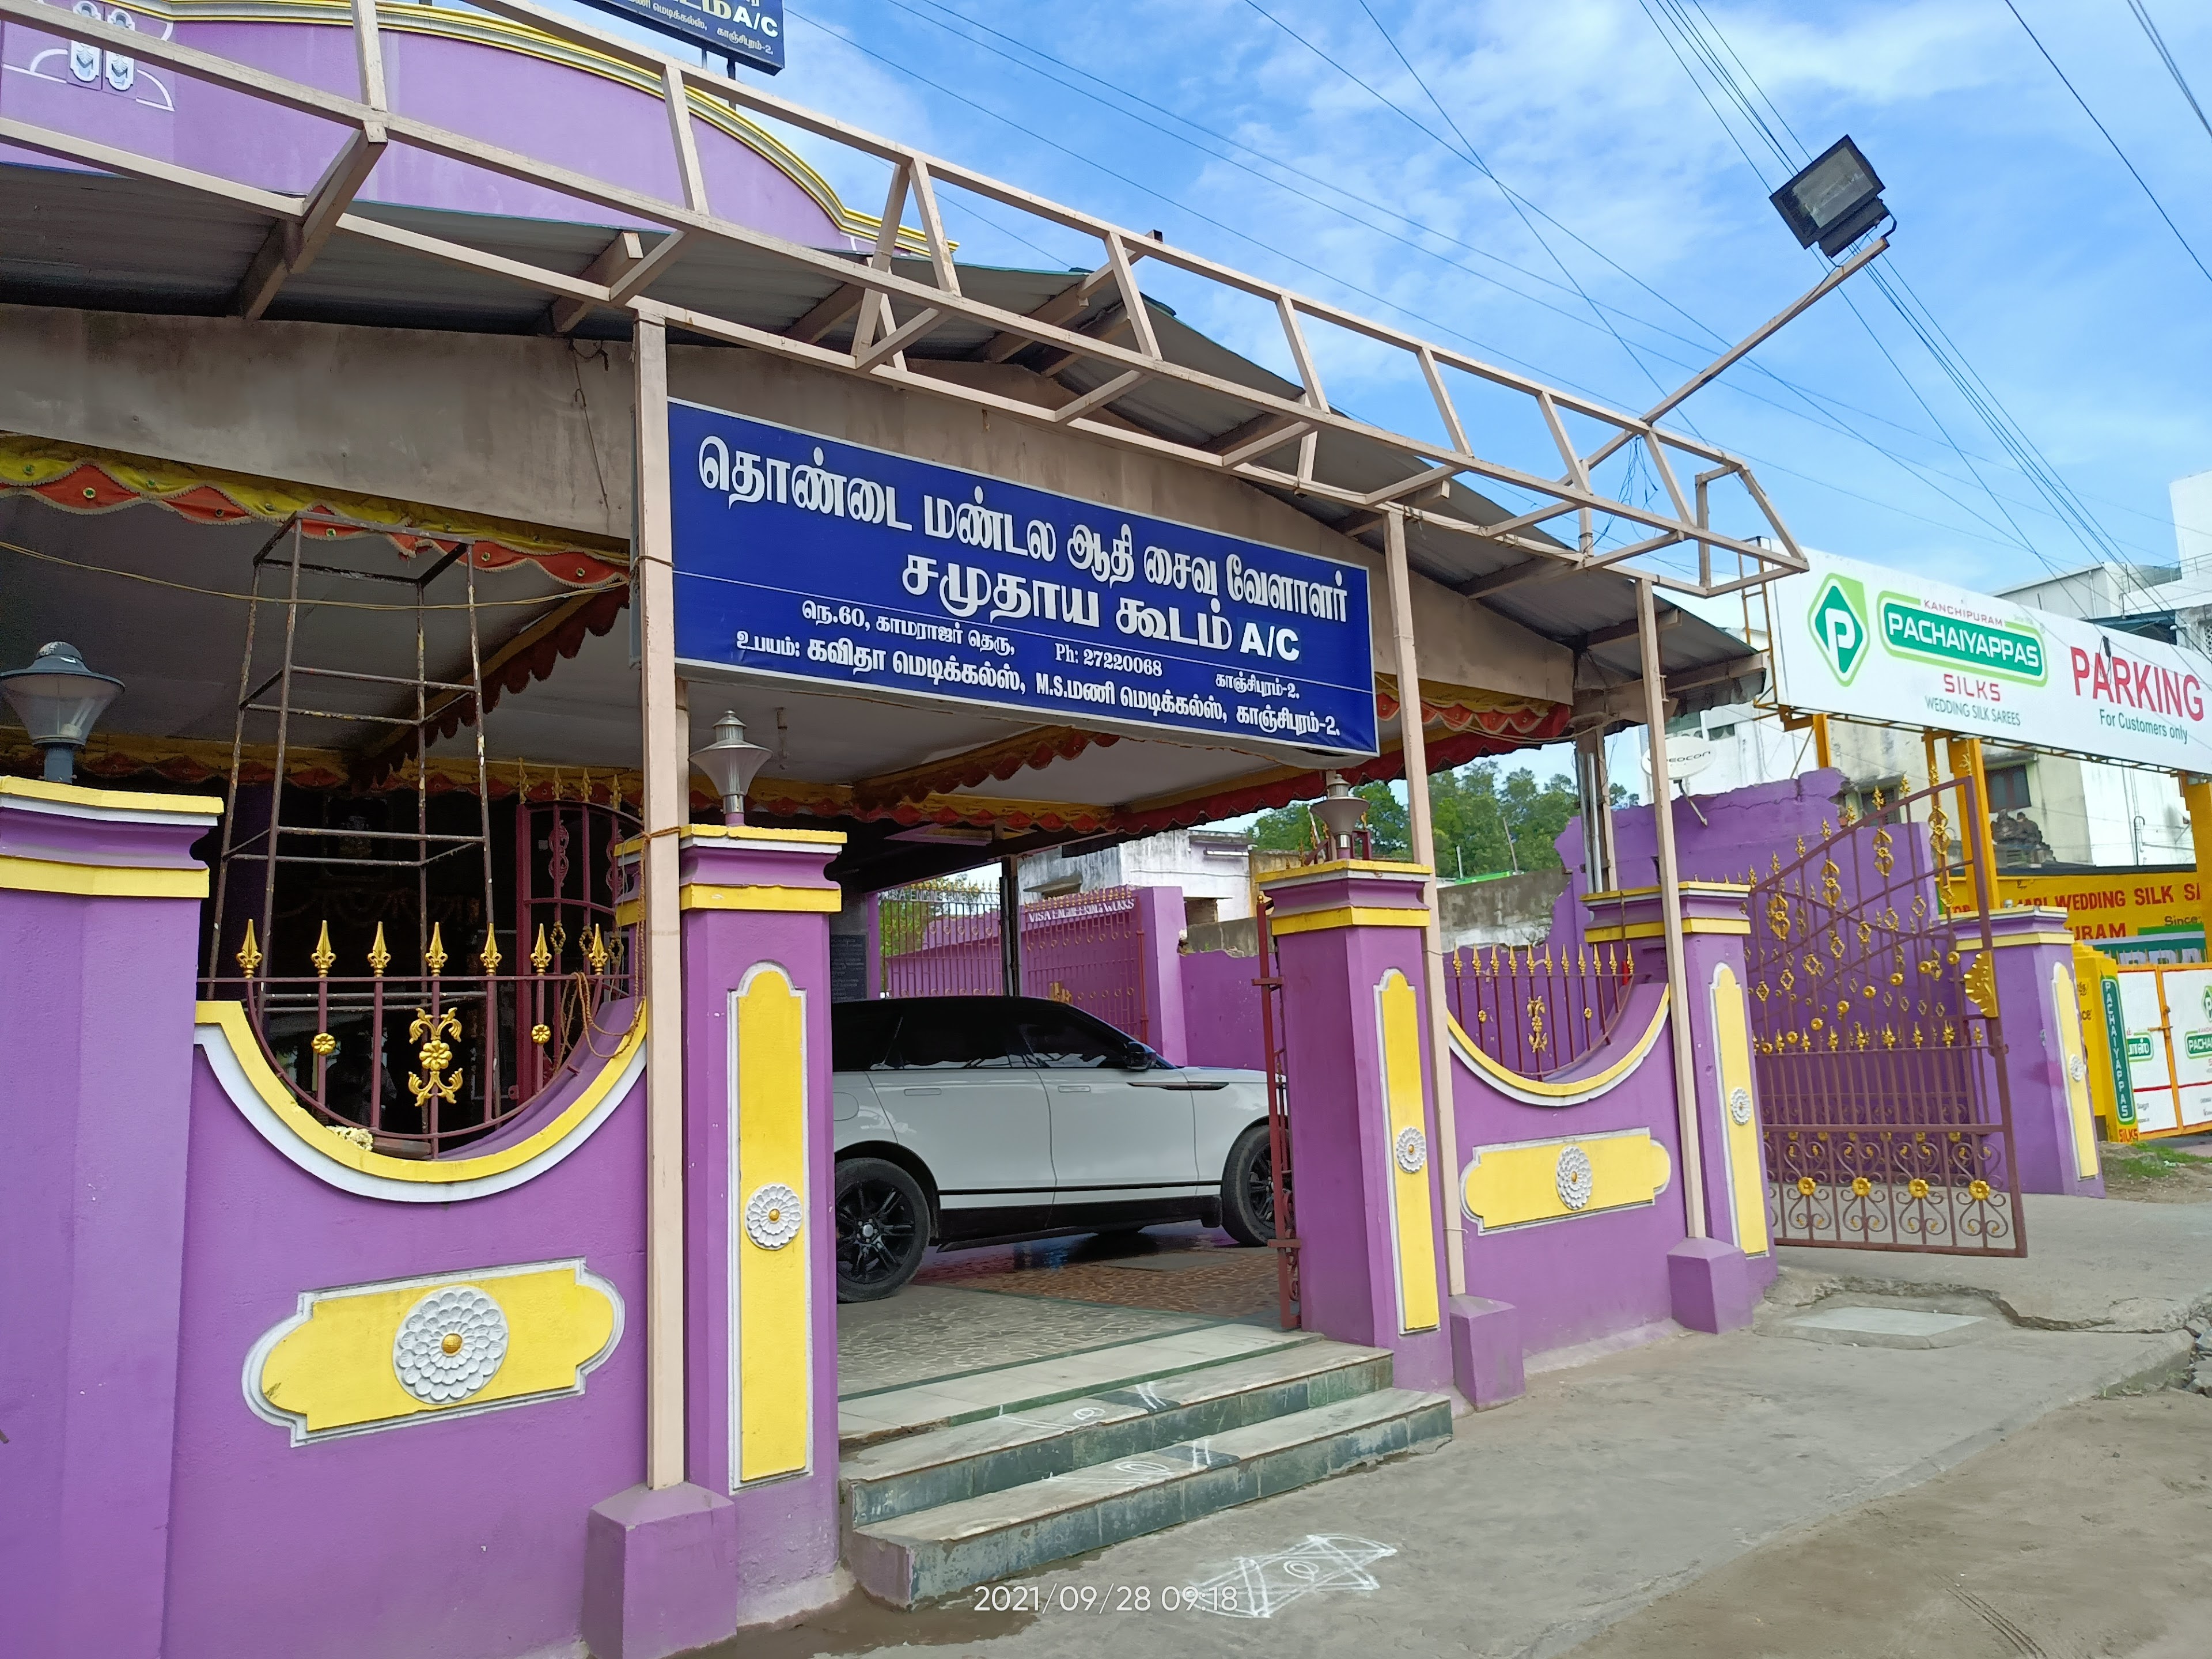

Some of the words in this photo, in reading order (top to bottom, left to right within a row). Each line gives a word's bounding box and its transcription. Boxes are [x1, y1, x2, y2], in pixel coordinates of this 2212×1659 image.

[732, 5, 778, 37] A/C
[699, 435, 912, 531] தொண்டை
[924, 486, 1056, 562] மண்டல
[1067, 524, 1134, 589] ஆதி
[1143, 546, 1219, 596] சைவ
[1226, 554, 1347, 622] வேளாளர்
[903, 555, 1100, 628] சமுதாய
[1116, 597, 1233, 650] கூடம்
[1240, 623, 1300, 661] A/C
[1923, 599, 2003, 627] KANCHIPURAM
[802, 600, 870, 631] நெ.60,
[876, 615, 963, 644] காமராஜர்
[968, 629, 1016, 656] தெரு,
[1055, 642, 1079, 664] Ph:
[1083, 649, 1162, 677] 27220068
[1888, 612, 2040, 668] PACHAIYAPPAS
[736, 631, 801, 658] உபயம்:
[807, 638, 887, 675] கவிதா
[892, 649, 1026, 695] மெடிக்கல்ஸ்,
[1120, 686, 1227, 724] மெடிக்கல்ஸ்,
[1944, 673, 2001, 702] SILKS
[2070, 646, 2204, 722] PARKING
[1925, 695, 1970, 717] WEDDING
[1972, 704, 1990, 721] SILK
[1991, 709, 2021, 726] SAREES
[2100, 709, 2115, 727] For
[2118, 712, 2167, 737] Customers
[2169, 725, 2188, 744] only
[2054, 890, 2126, 912] WEDDING
[2134, 885, 2175, 906] SILK
[2105, 982, 2128, 1117] PACHAIYAPPAS
